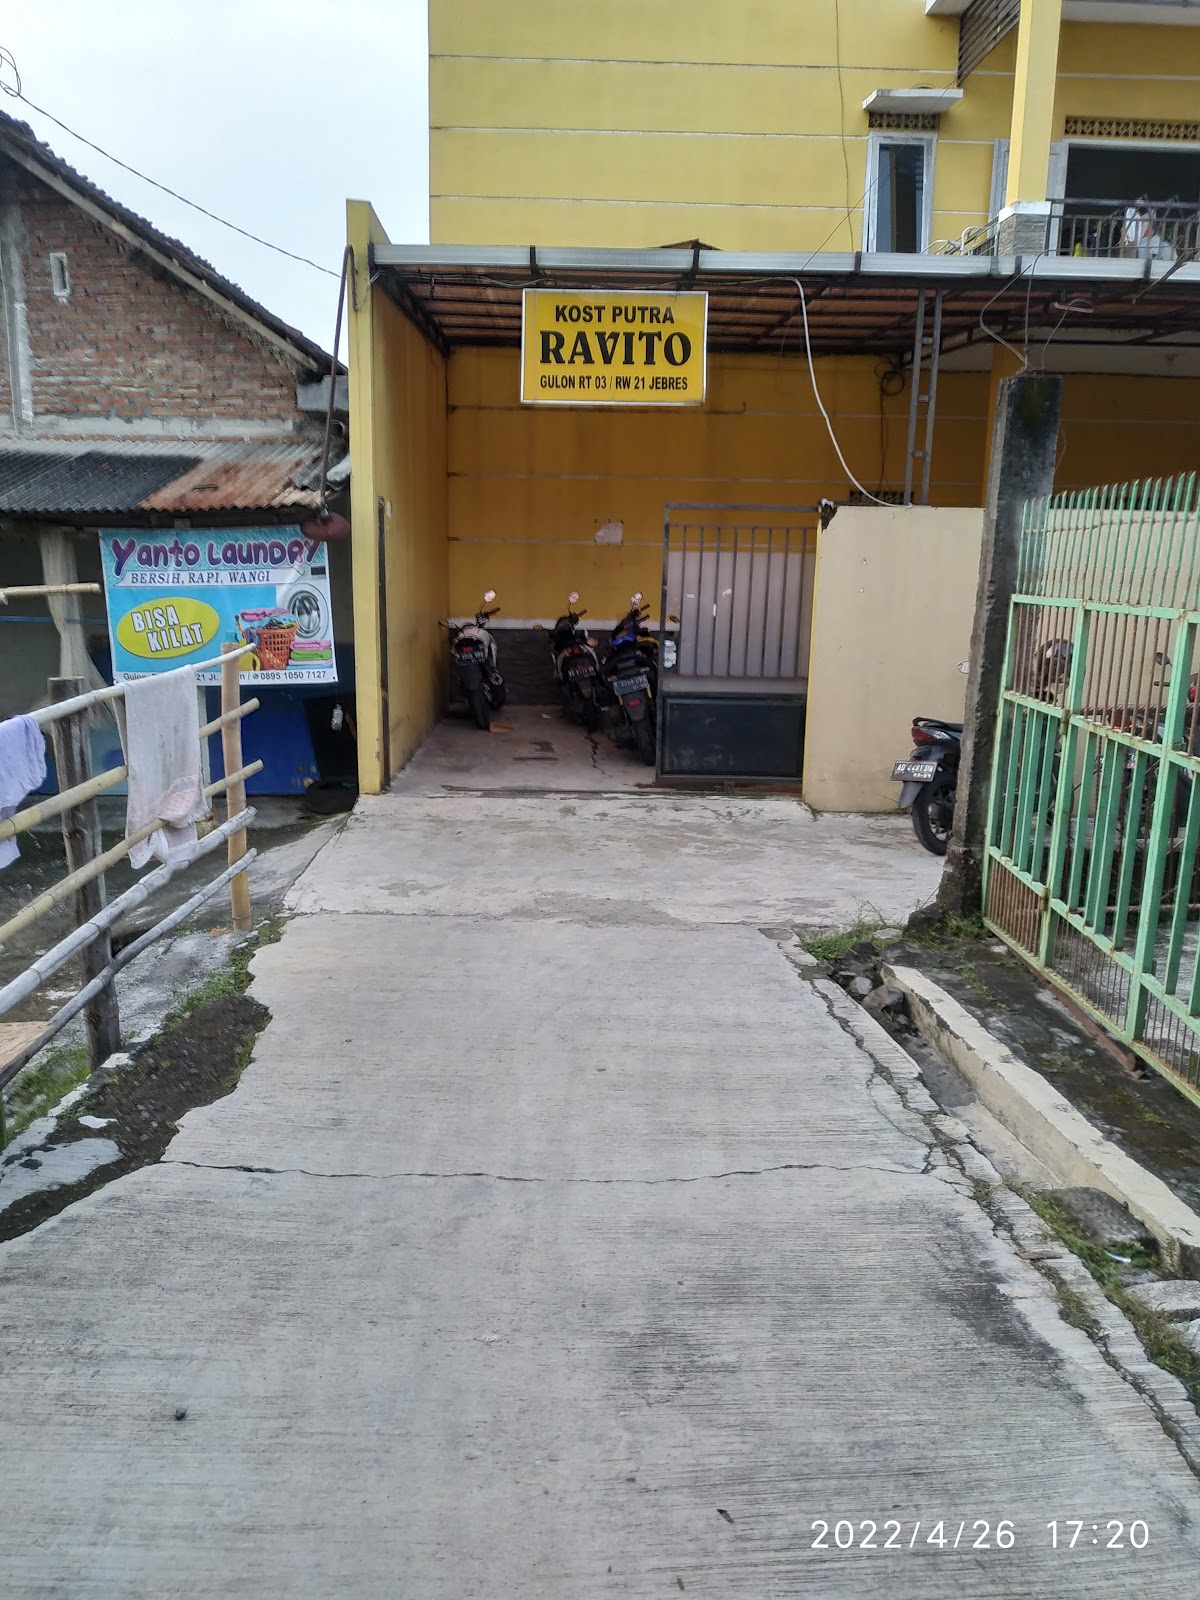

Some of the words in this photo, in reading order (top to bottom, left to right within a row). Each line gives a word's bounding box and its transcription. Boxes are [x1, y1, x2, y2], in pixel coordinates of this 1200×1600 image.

[555, 304, 606, 323] KOST
[612, 305, 675, 324] PUTRA
[539, 329, 692, 366] RAVITO
[540, 374, 576, 389] GULON
[579, 375, 592, 389] RT
[595, 375, 607, 389] 03
[615, 375, 631, 390] RW
[634, 376, 646, 390] 21
[649, 376, 688, 390] JEBRES
[111, 538, 201, 577] Yanto
[130, 571, 185, 585] BERSIH,
[188, 571, 224, 584] RAPI,
[228, 570, 271, 583] WANGI
[131, 604, 180, 633] BISA
[146, 622, 204, 653] KILAT
[196, 674, 205, 682] 21
[260, 672, 281, 680] 0895
[284, 671, 304, 680] 1050
[306, 670, 327, 679] 7127
